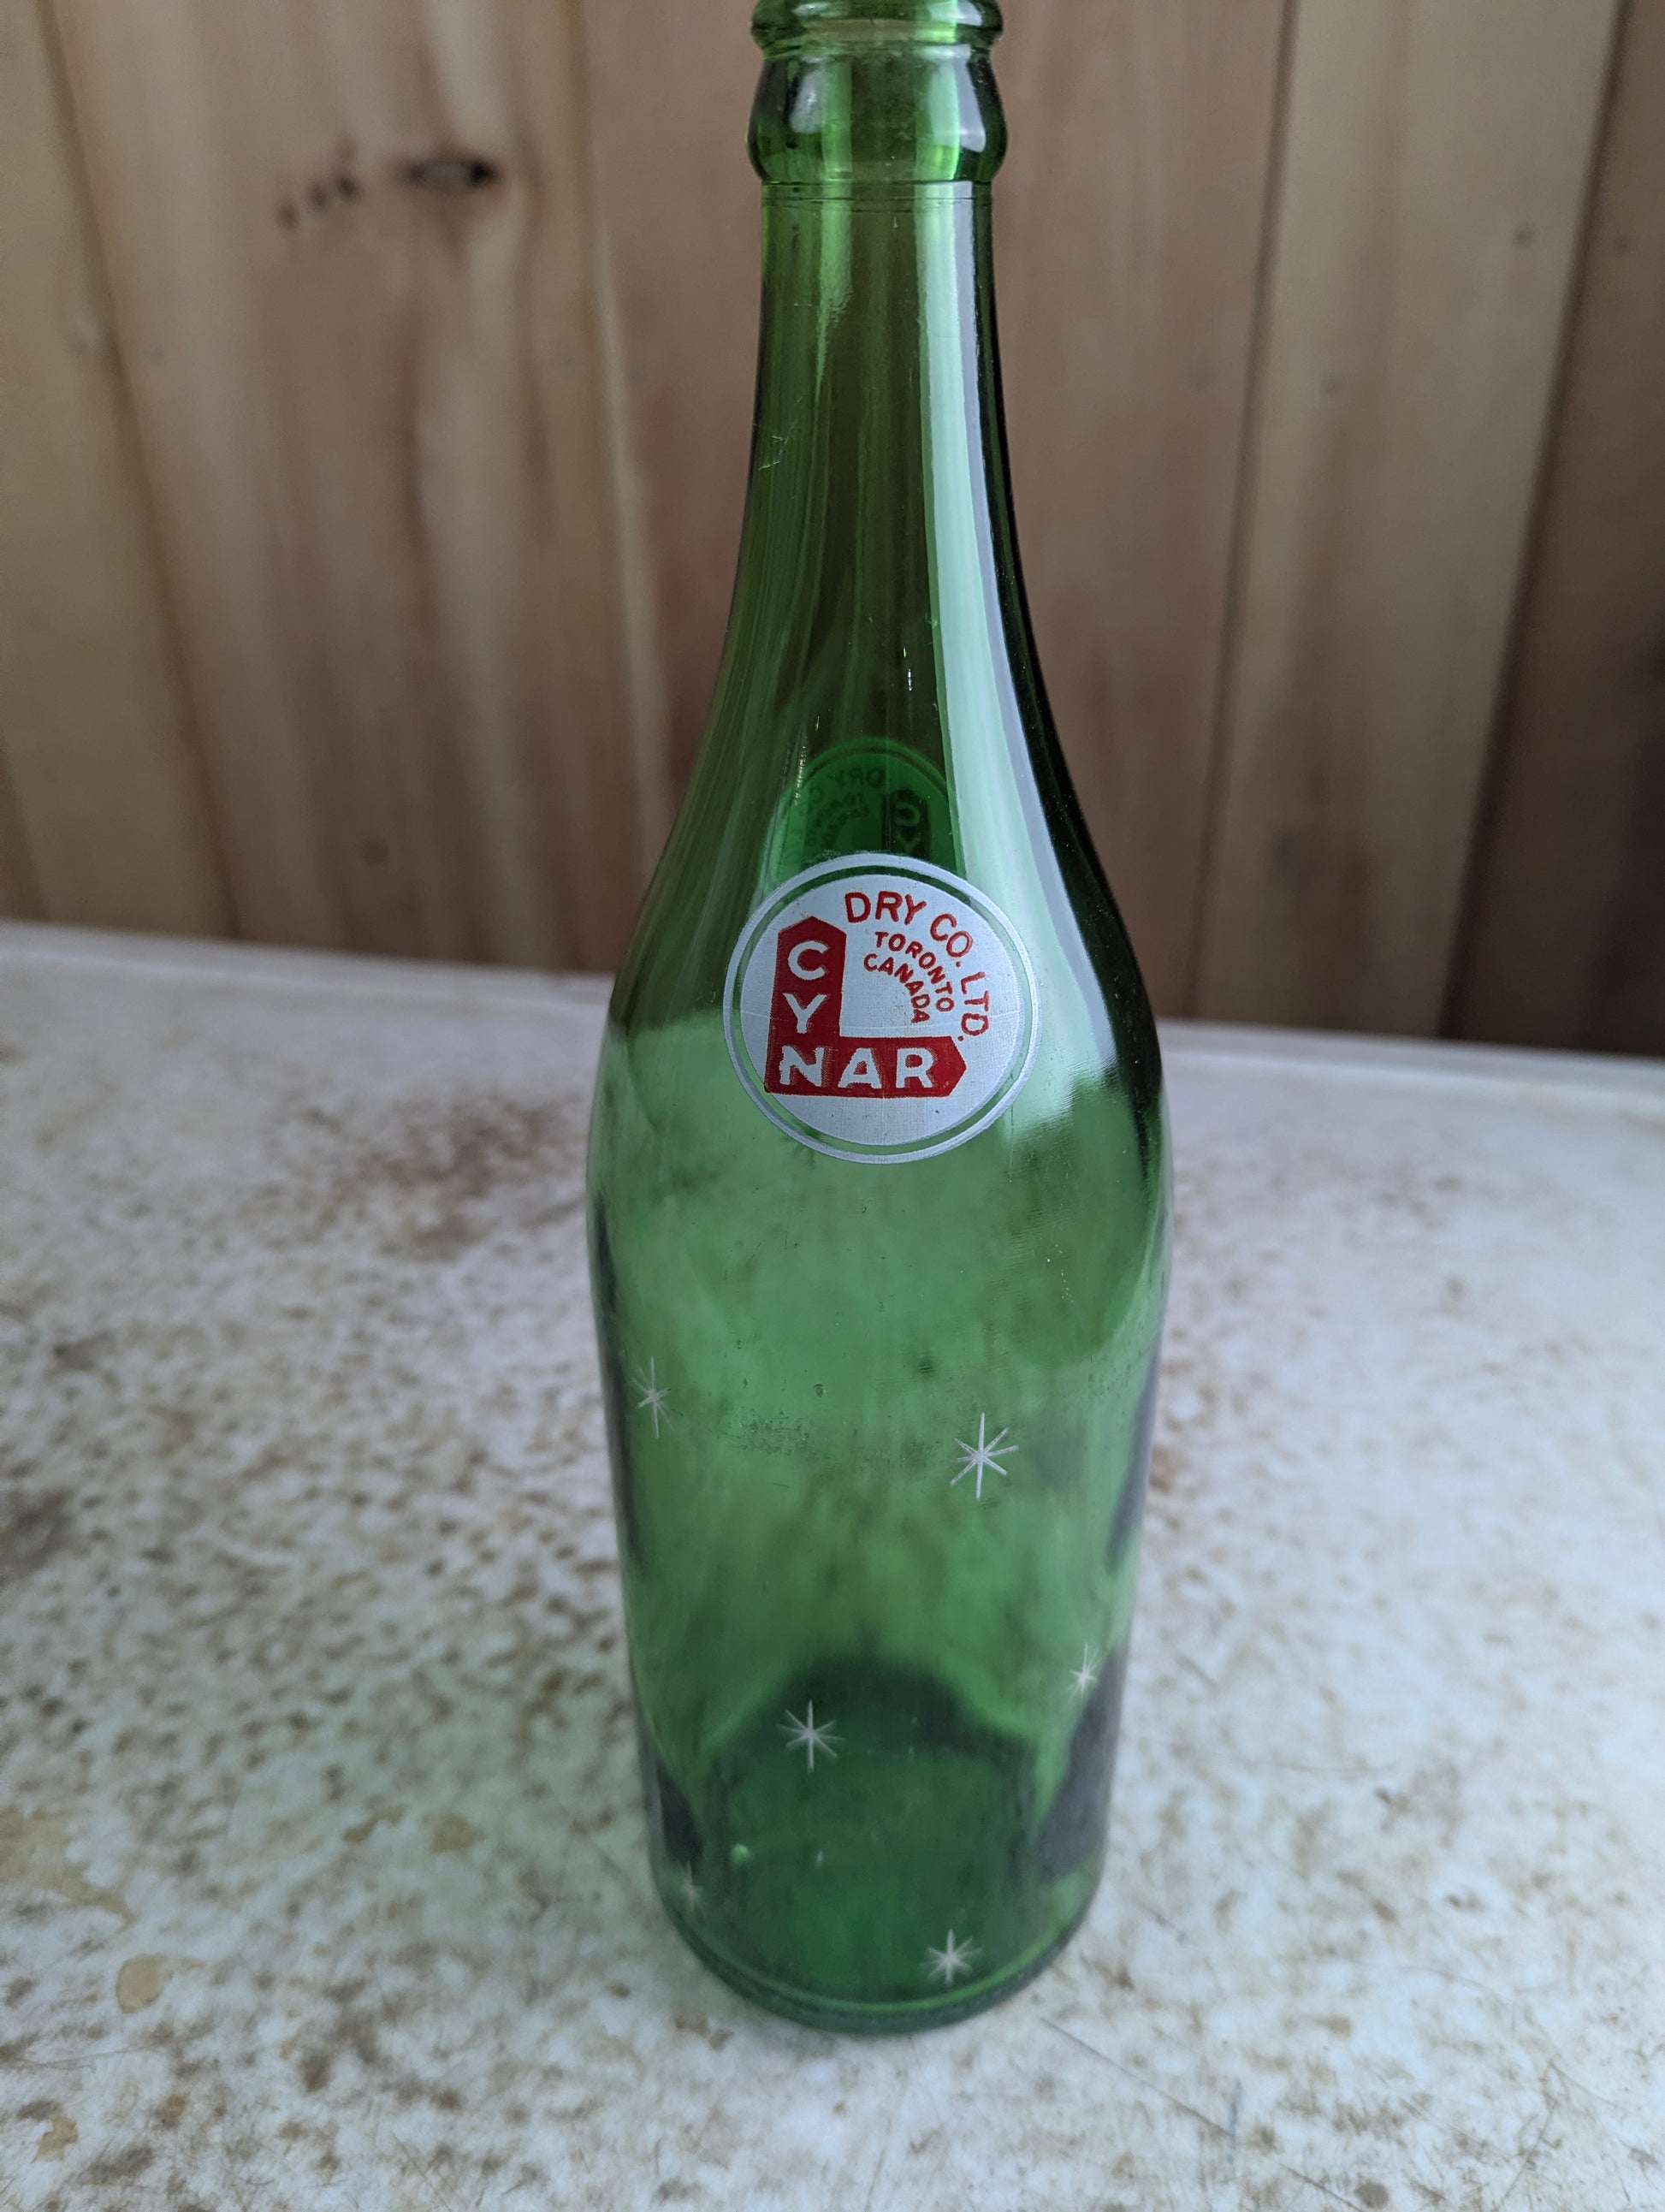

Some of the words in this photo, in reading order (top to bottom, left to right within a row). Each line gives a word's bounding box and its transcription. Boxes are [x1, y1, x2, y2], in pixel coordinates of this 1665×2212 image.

[844, 890, 927, 925] DRY
[930, 913, 974, 968] CO.
[957, 971, 990, 1041] LTD.
[863, 953, 931, 1024] CANADA
[875, 931, 955, 1012] TORONTO
